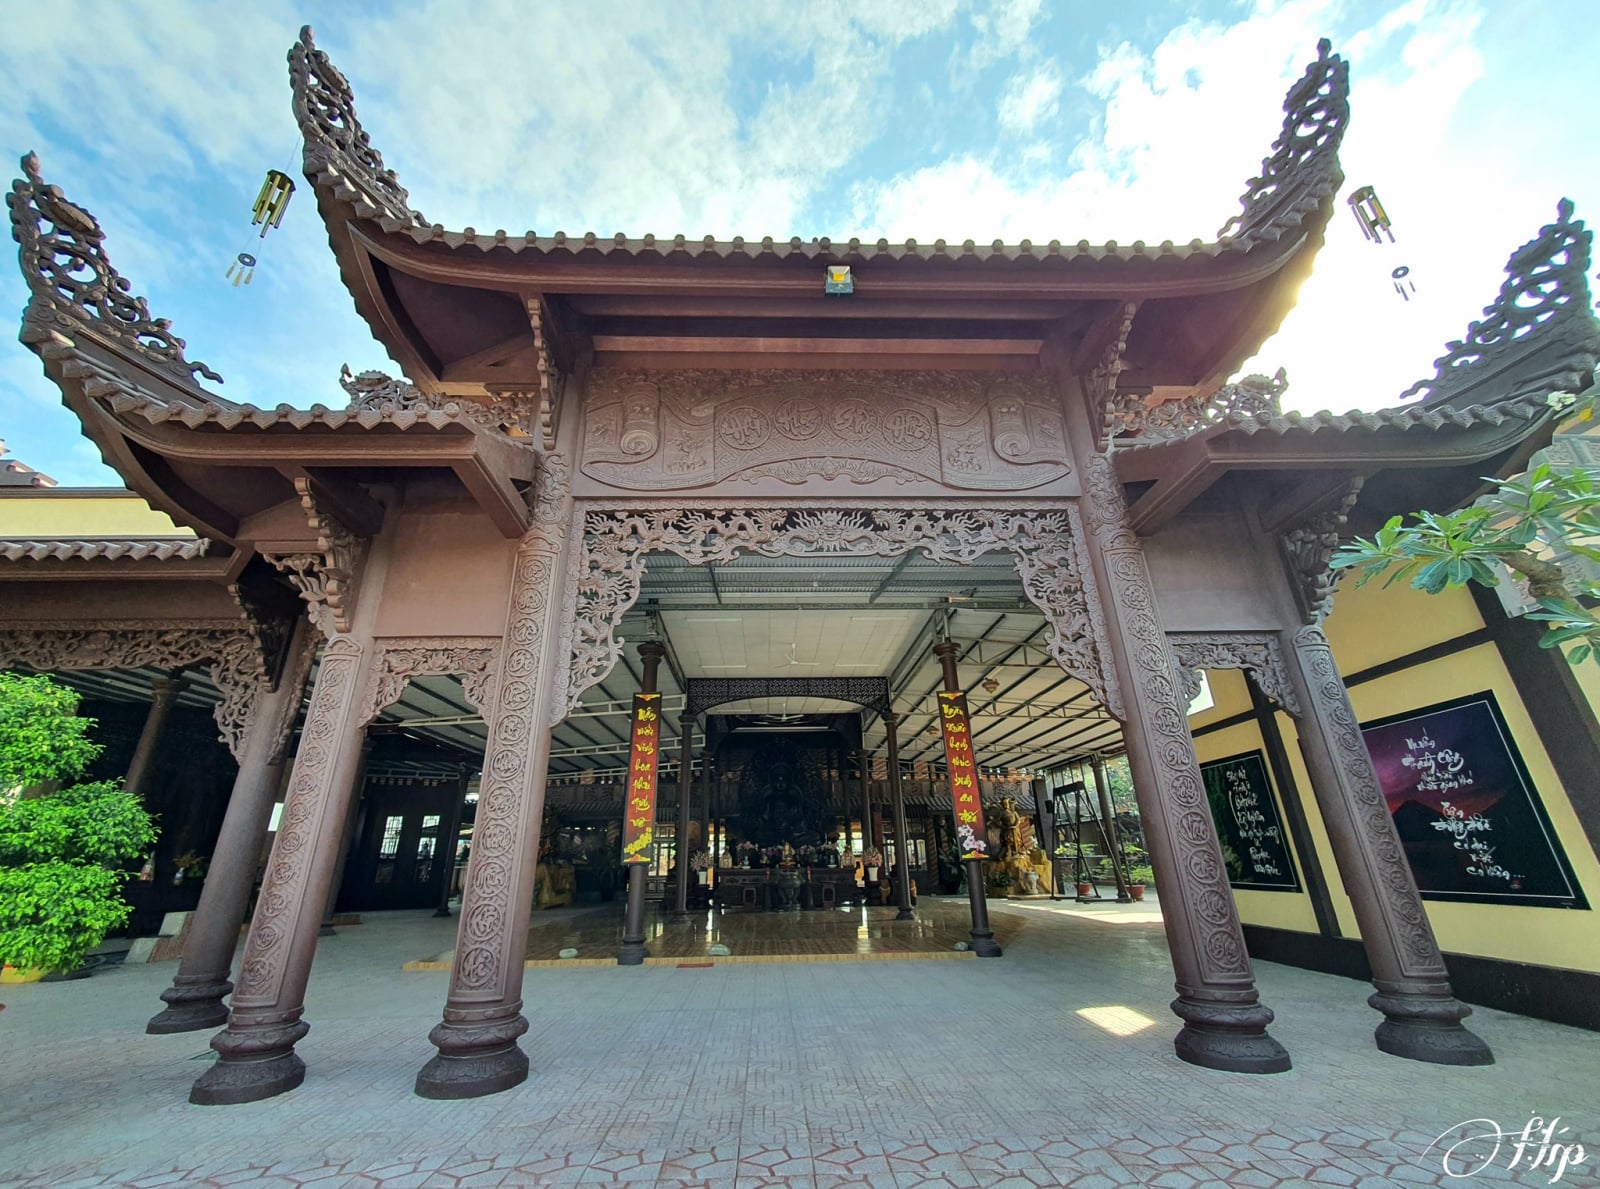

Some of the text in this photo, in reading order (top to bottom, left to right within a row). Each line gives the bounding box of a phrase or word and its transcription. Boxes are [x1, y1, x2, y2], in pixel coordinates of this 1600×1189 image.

[636, 724, 654, 736] mới
[635, 742, 654, 755] vinh
[949, 736, 968, 752] hạnh
[634, 758, 652, 771] hoa
[952, 754, 971, 770] phúc
[632, 776, 651, 795] phú
[954, 772, 972, 788] bình
